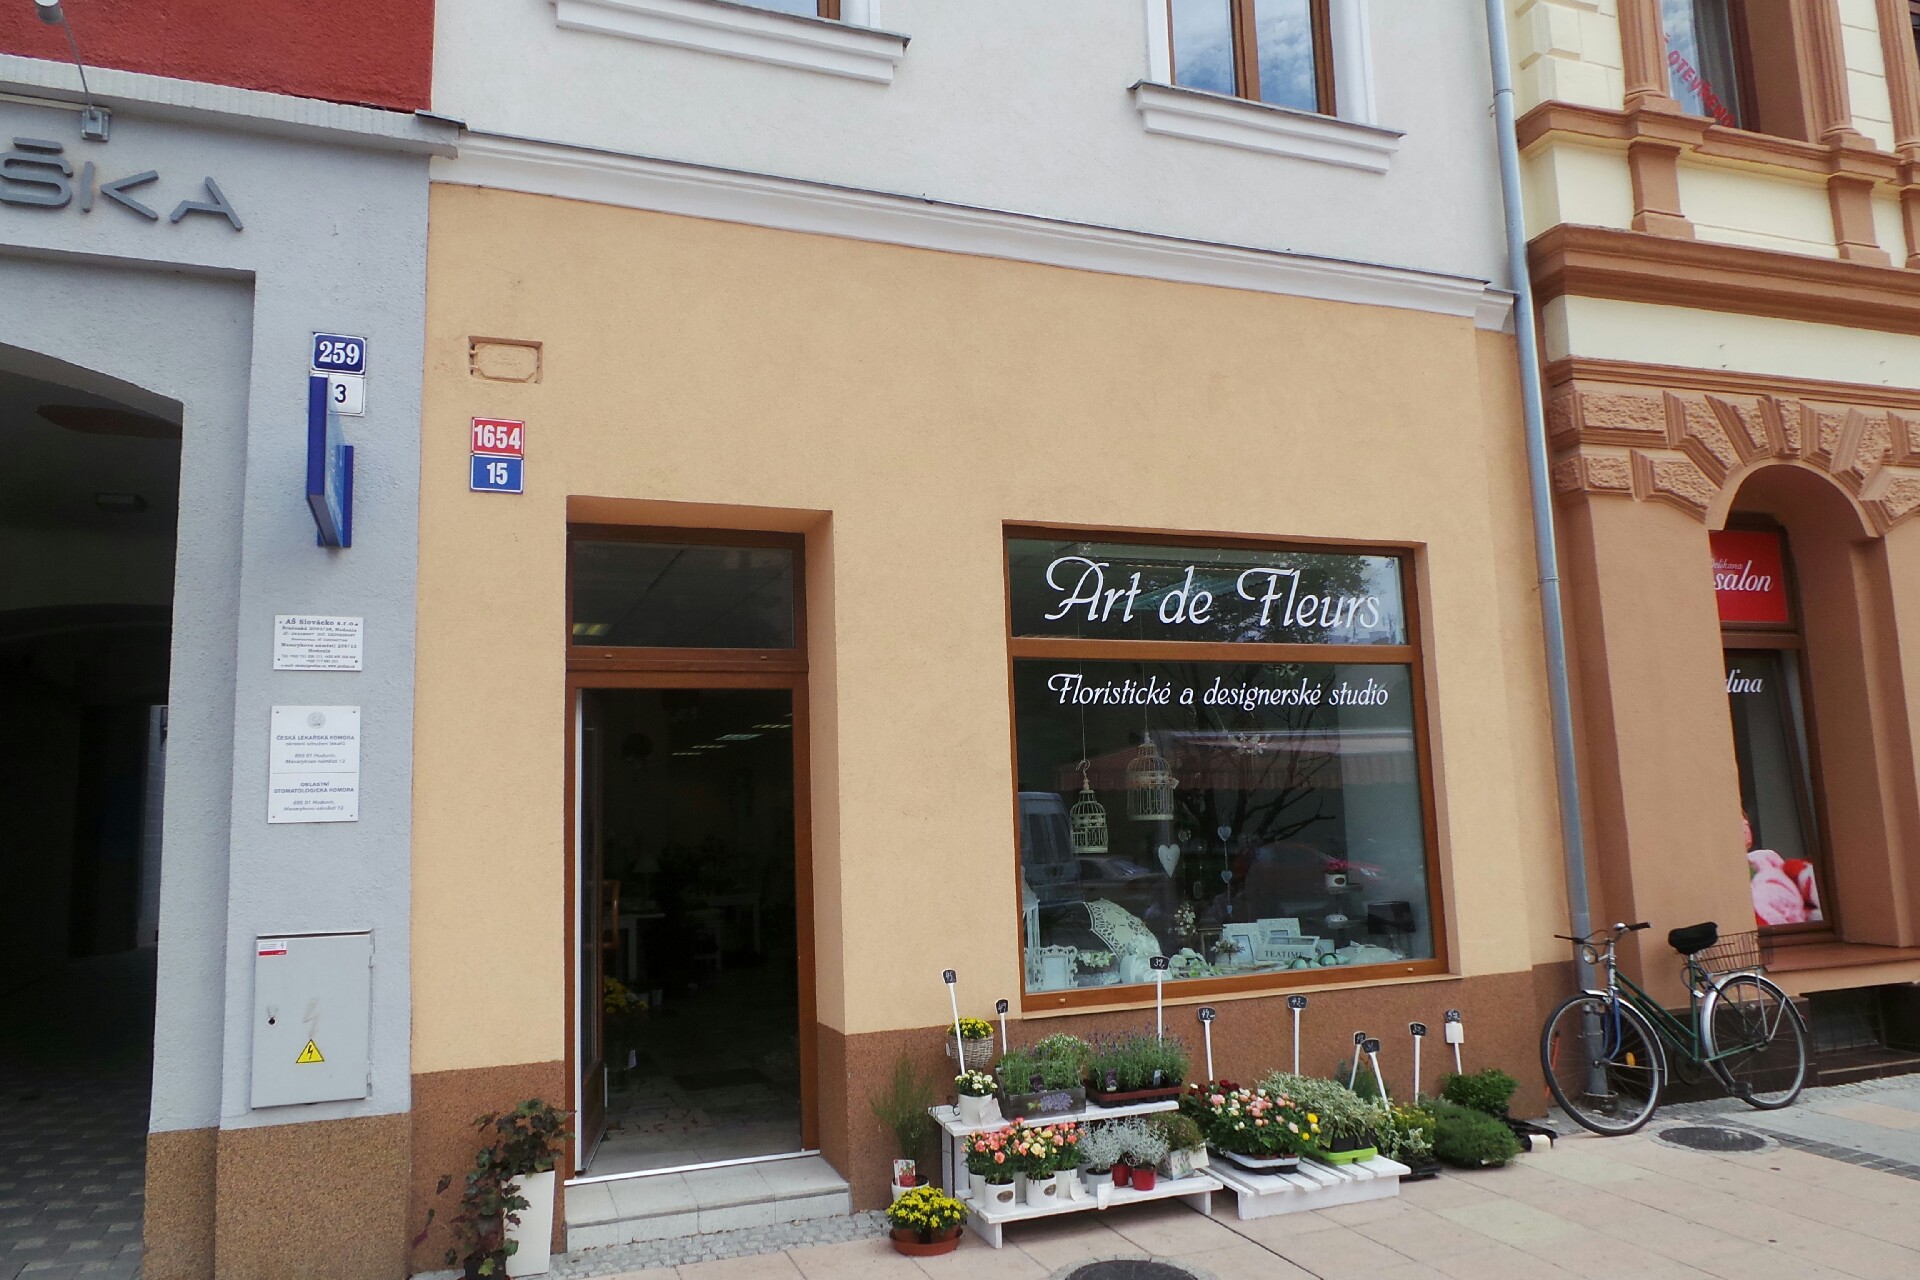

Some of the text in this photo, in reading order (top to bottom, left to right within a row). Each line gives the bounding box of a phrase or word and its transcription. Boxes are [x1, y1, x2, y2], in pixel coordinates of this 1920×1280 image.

[318, 340, 361, 366] 259
[474, 424, 521, 450] 1654
[486, 462, 508, 485] 15
[1714, 560, 1772, 592] salon
[1044, 555, 1380, 628] Art de Fleurs
[1047, 673, 1171, 705] Floristické
[1179, 687, 1194, 705] a
[1203, 676, 1322, 711] designerské
[1725, 668, 1763, 693] lina
